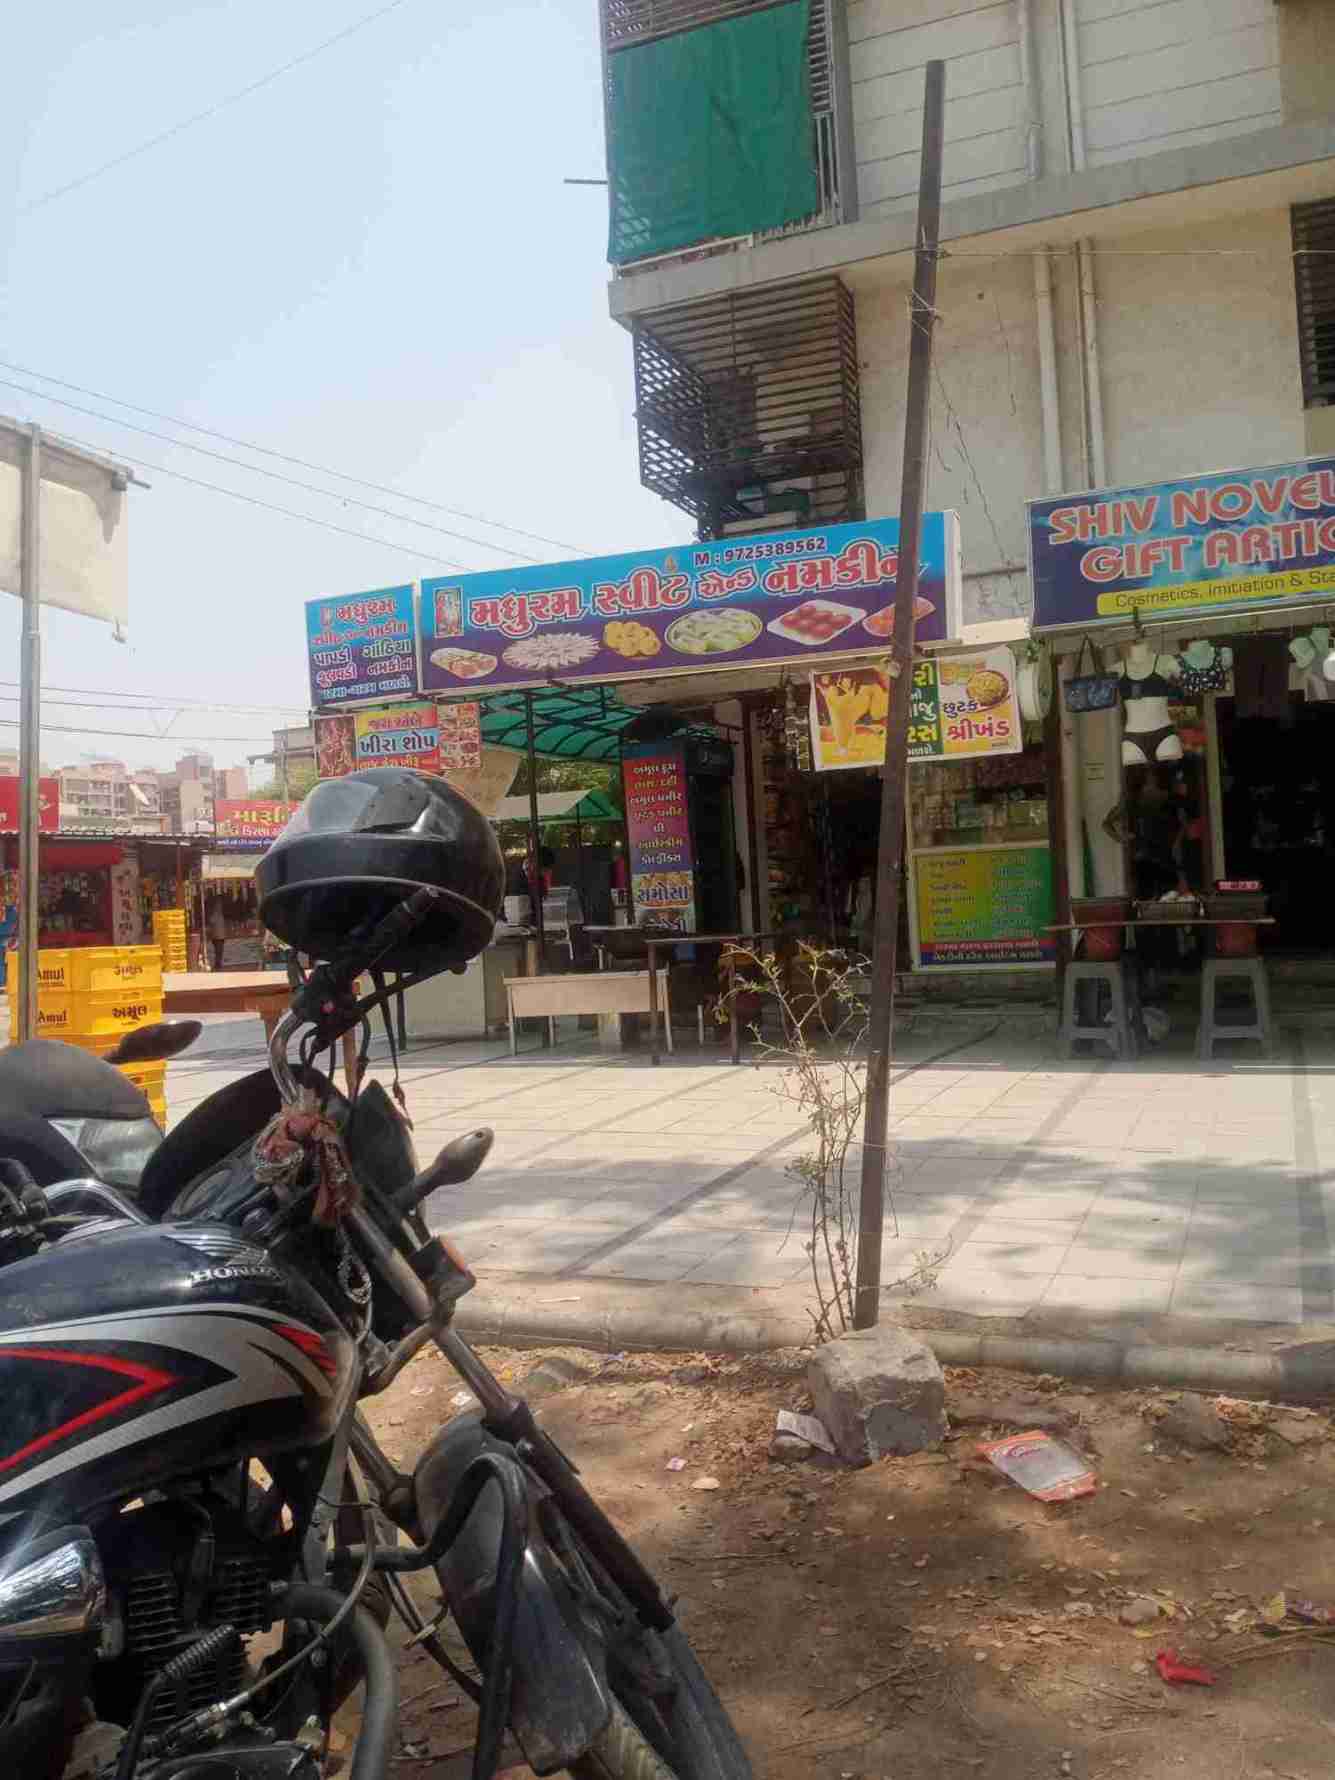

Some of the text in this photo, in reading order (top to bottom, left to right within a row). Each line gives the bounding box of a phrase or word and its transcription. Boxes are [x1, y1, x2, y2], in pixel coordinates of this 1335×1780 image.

[1049, 470, 1335, 545] SHIV NOVEL
[723, 538, 826, 563] 9725389562
[1080, 536, 1192, 583] GIFT
[1290, 573, 1304, 586] &
[336, 598, 395, 625] મધુરમ
[470, 588, 582, 637] મધુરમ
[594, 567, 690, 614] સ્વીટ
[313, 644, 352, 665] પાપડી
[947, 716, 1010, 740] શ્રીખંડ
[402, 731, 436, 751] શોપ
[38, 967, 65, 981] Amul
[38, 1010, 67, 1023] Amul
